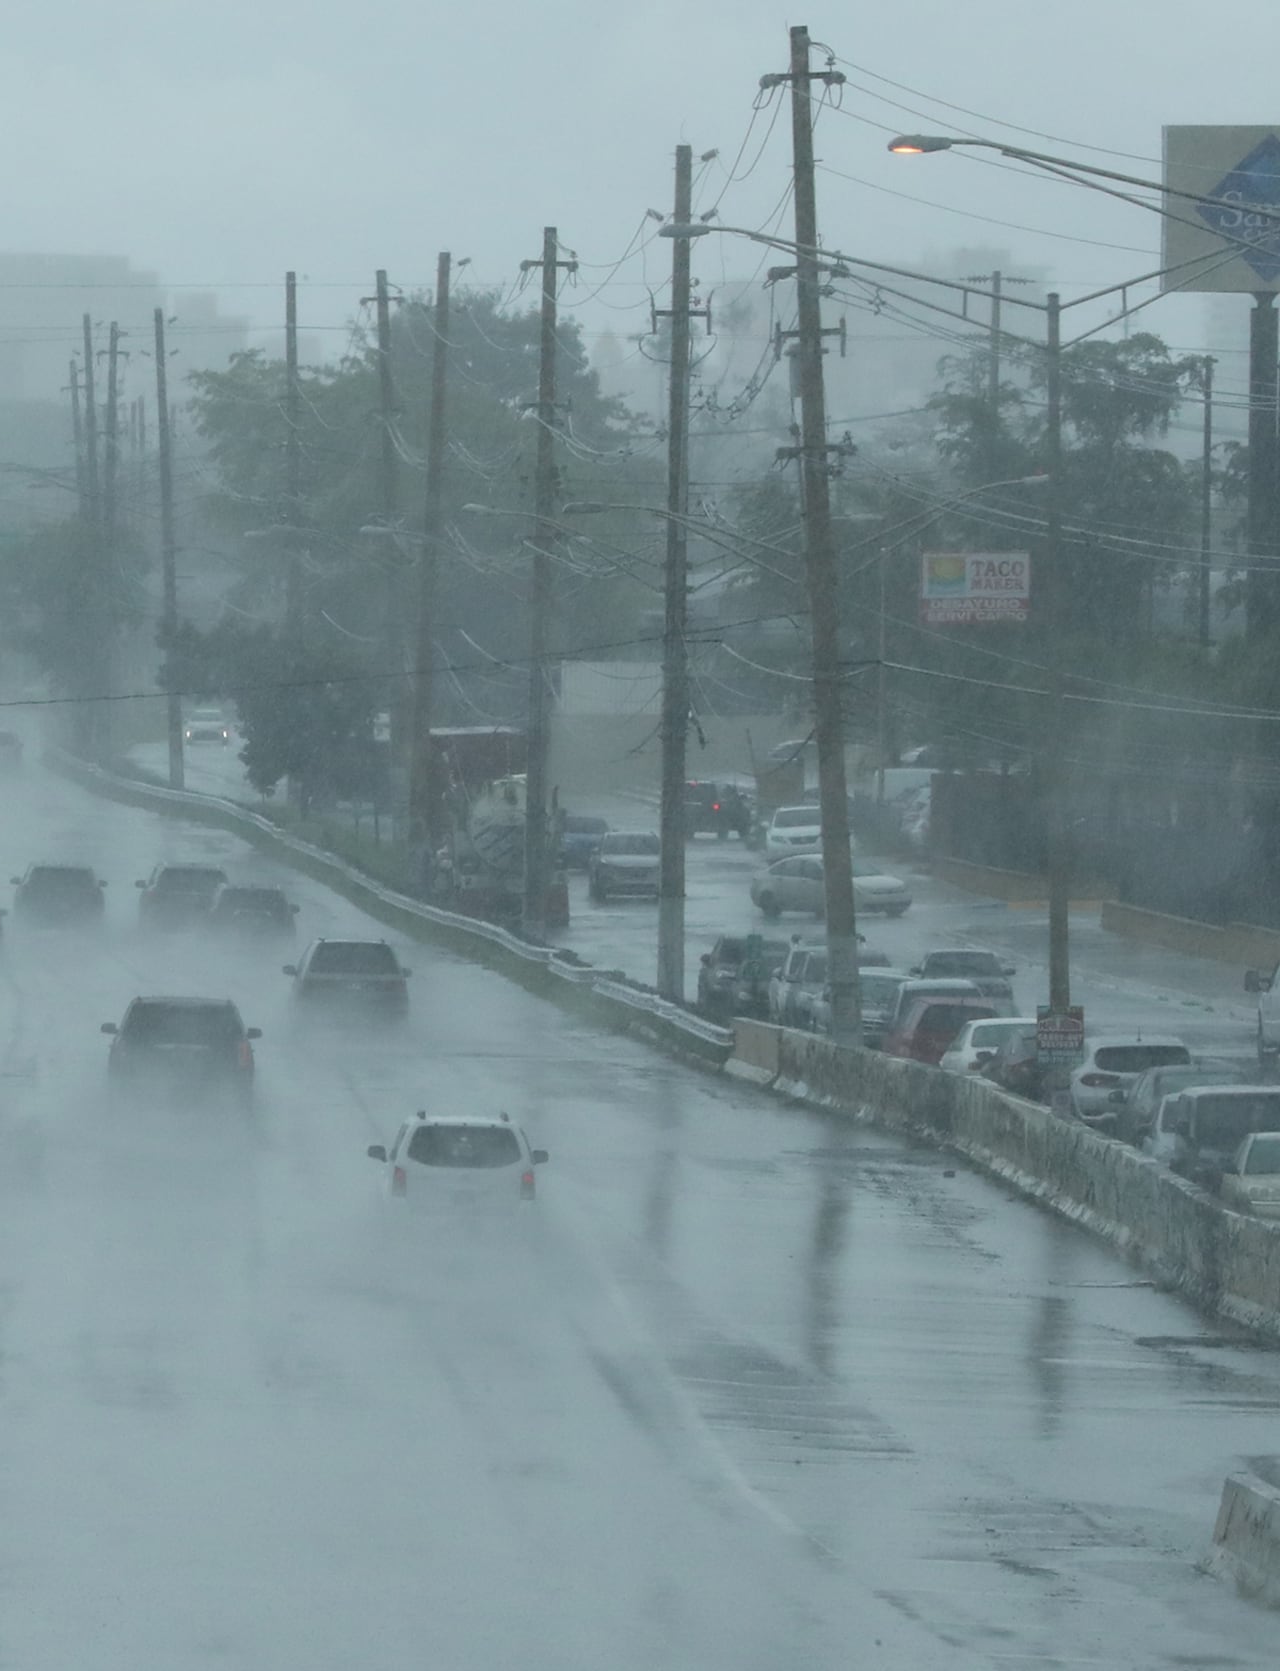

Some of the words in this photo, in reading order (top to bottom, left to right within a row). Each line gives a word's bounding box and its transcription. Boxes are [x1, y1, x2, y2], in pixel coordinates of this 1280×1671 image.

[970, 560, 1025, 577] TACO
[970, 578, 1026, 591] MAKER
[930, 599, 1021, 609] DESAYUNO
